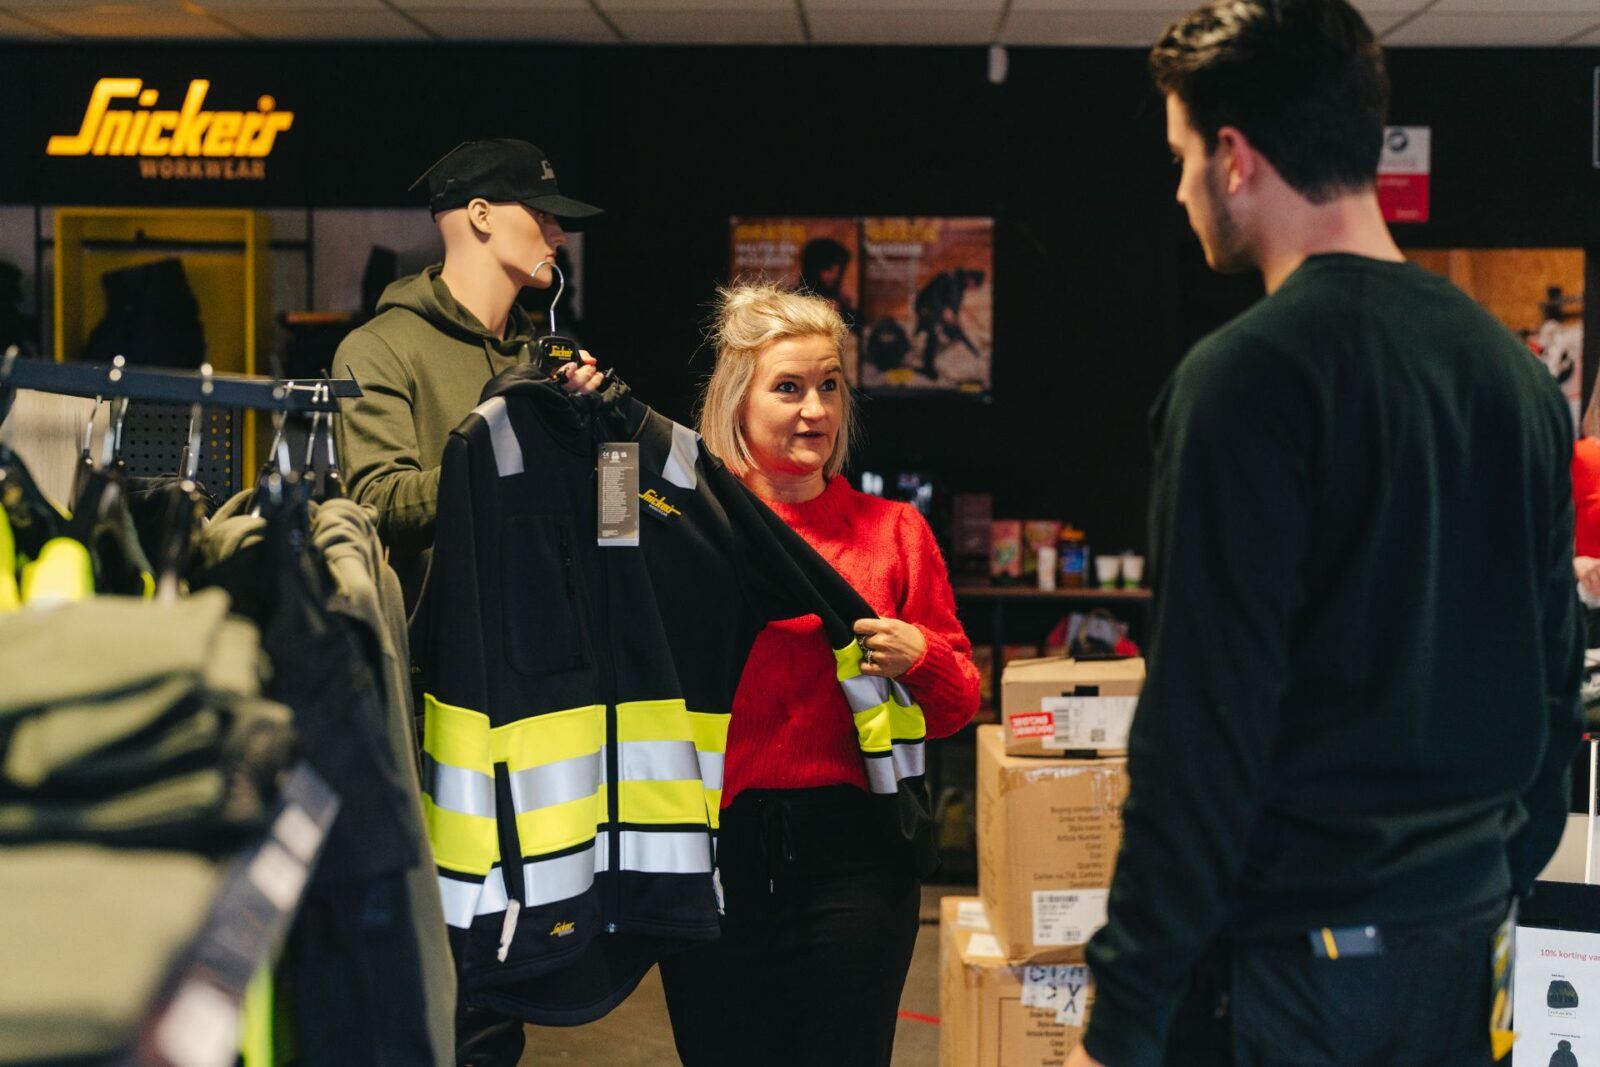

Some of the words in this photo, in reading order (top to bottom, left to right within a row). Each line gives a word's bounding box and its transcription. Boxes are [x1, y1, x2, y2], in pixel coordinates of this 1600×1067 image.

[46, 77, 295, 156] Snickers
[139, 159, 266, 180] WORKWEAR
[638, 488, 681, 515] Snickers
[1540, 948, 1557, 957] 10%
[1558, 950, 1587, 961] korting
